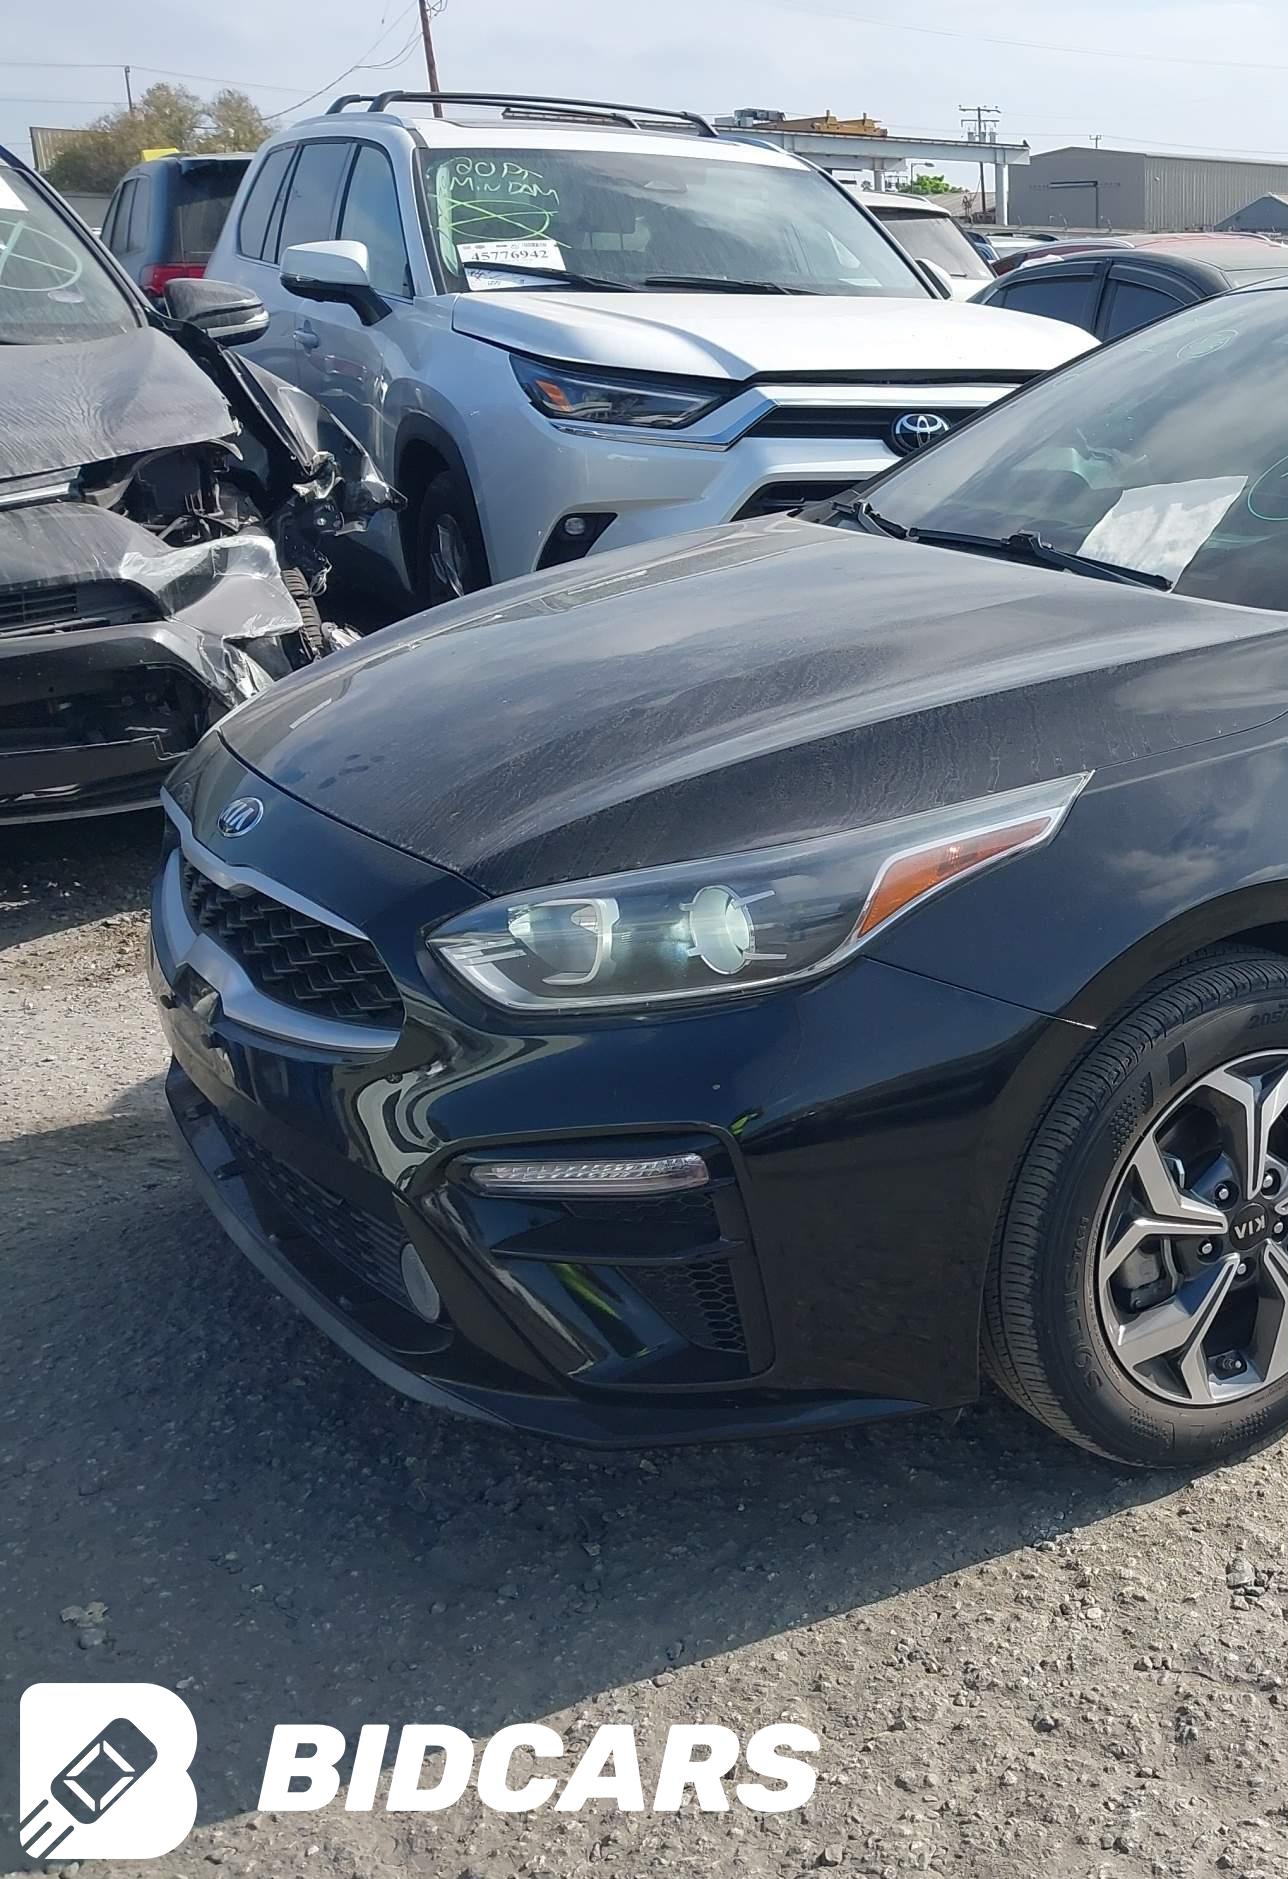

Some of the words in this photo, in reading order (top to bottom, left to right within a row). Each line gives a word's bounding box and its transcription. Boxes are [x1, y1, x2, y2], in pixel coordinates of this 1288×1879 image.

[452, 156, 496, 177] 20
[502, 162, 543, 180] PT
[508, 181, 560, 206] DAM
[471, 250, 549, 261] 45776942
[1233, 1214, 1266, 1240] KIA
